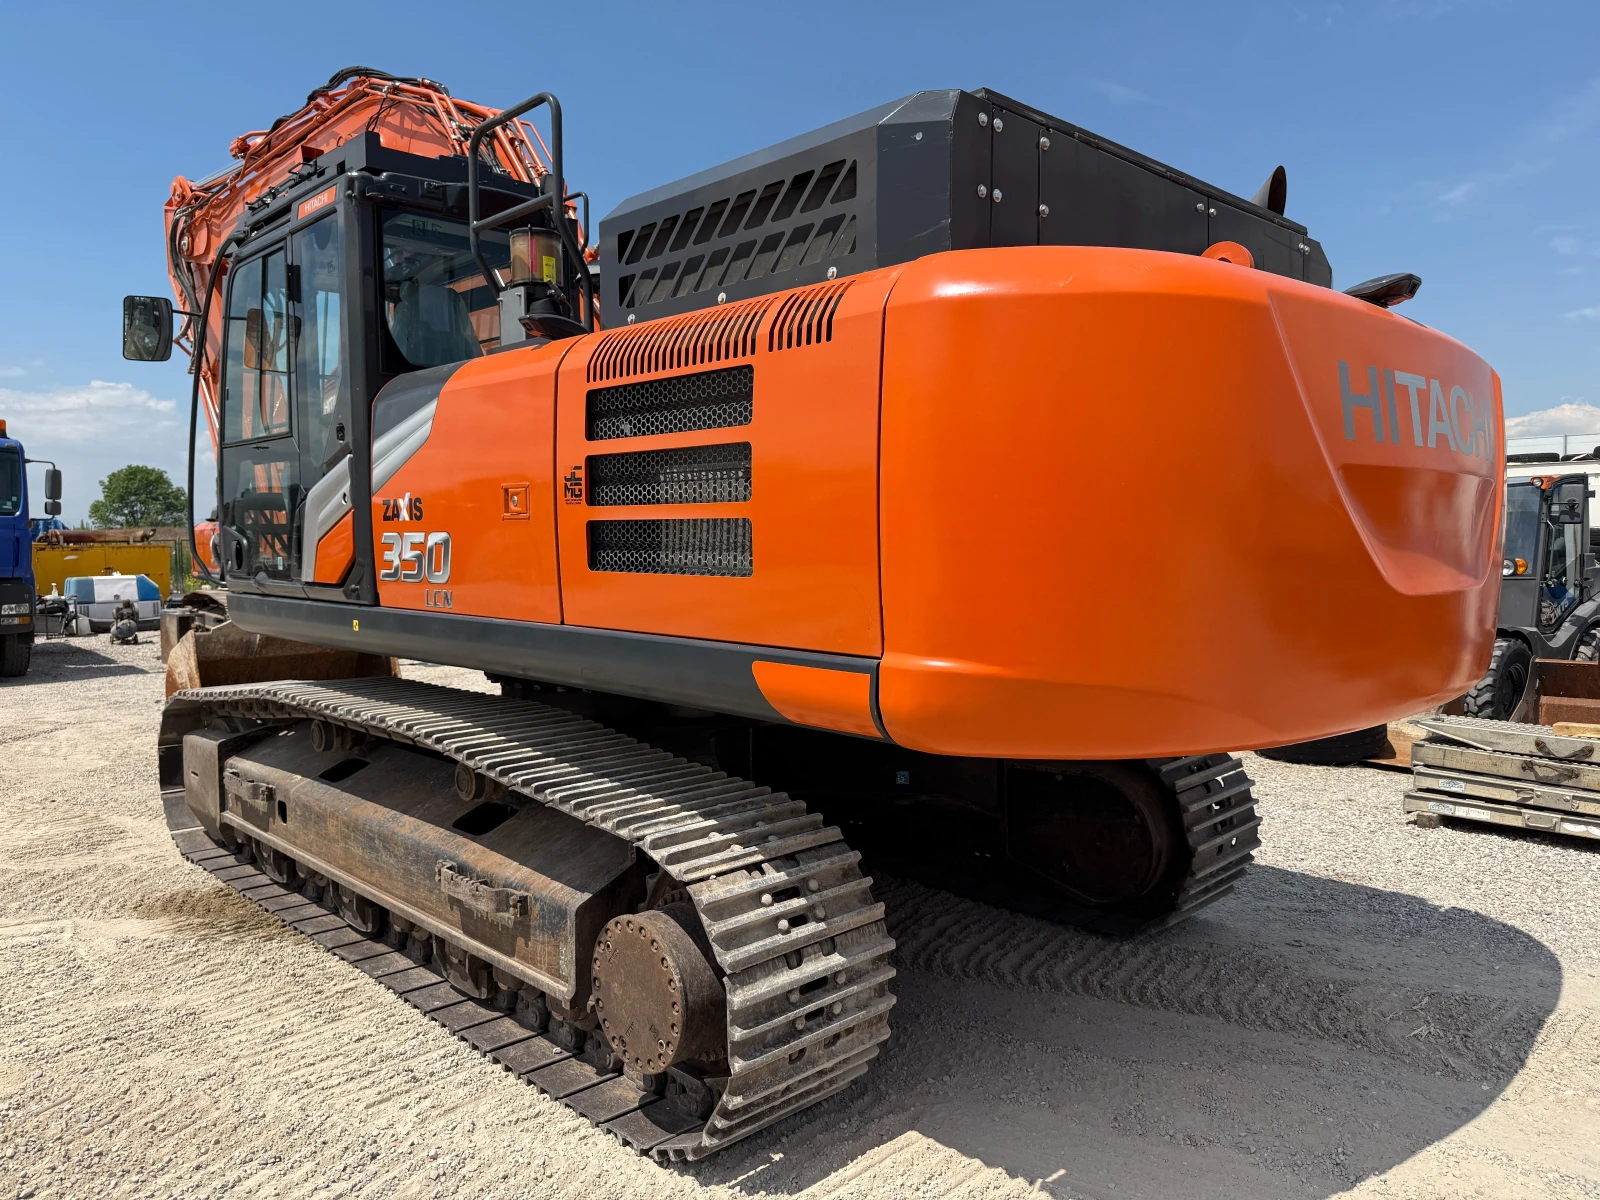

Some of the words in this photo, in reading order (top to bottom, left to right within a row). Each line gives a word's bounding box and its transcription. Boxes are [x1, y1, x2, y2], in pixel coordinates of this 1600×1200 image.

[304, 192, 328, 213] HITACHI
[1337, 360, 1494, 462] HITACHI
[382, 492, 424, 522] ZAXIS
[380, 531, 452, 584] 350
[425, 588, 453, 609] LCN
